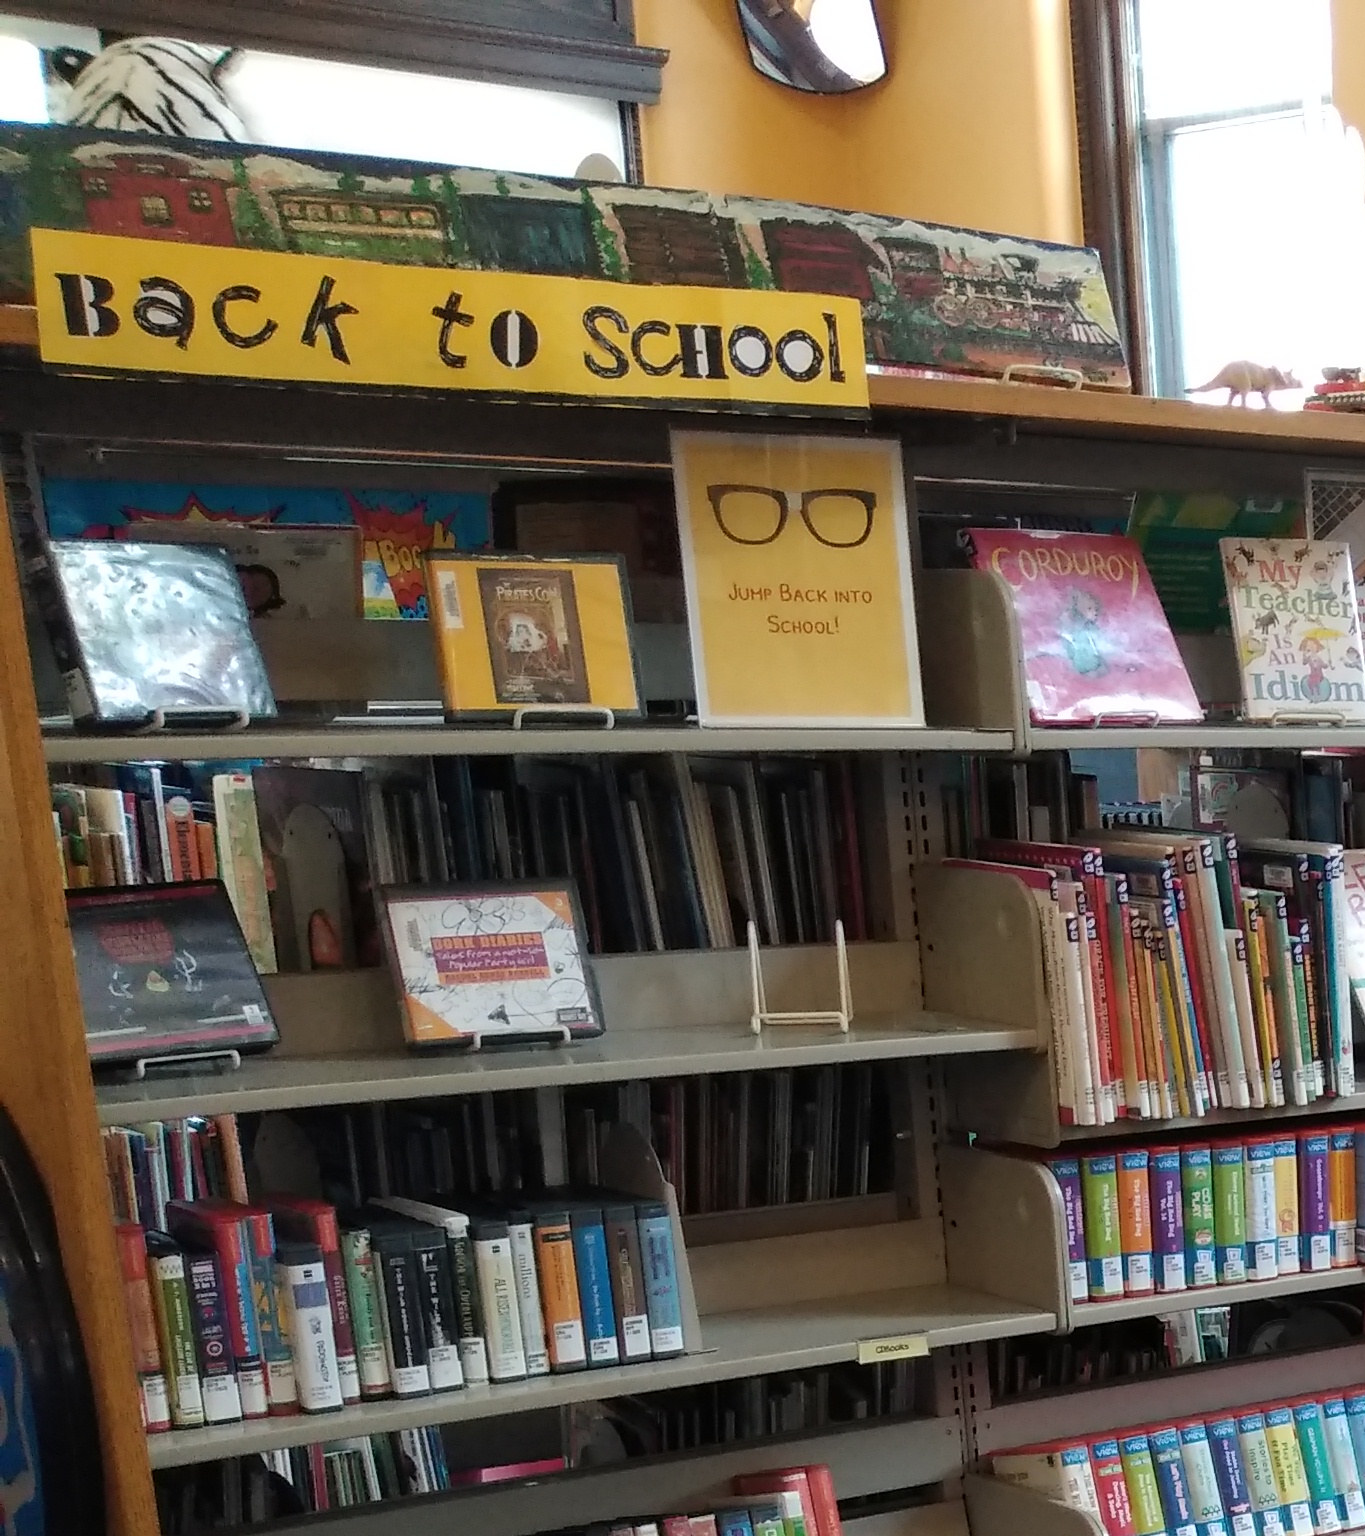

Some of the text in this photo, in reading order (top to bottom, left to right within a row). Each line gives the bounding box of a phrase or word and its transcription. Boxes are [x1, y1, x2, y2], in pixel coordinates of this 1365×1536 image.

[54, 272, 539, 370] Back to
[991, 547, 1140, 601] CORDUROY
[1257, 558, 1302, 590] My
[728, 583, 873, 604] JUMP BACK INTO
[1238, 585, 1353, 620] Teacher
[767, 615, 840, 635] SCHOOL!
[1274, 634, 1293, 650] Is
[1268, 651, 1297, 666] An
